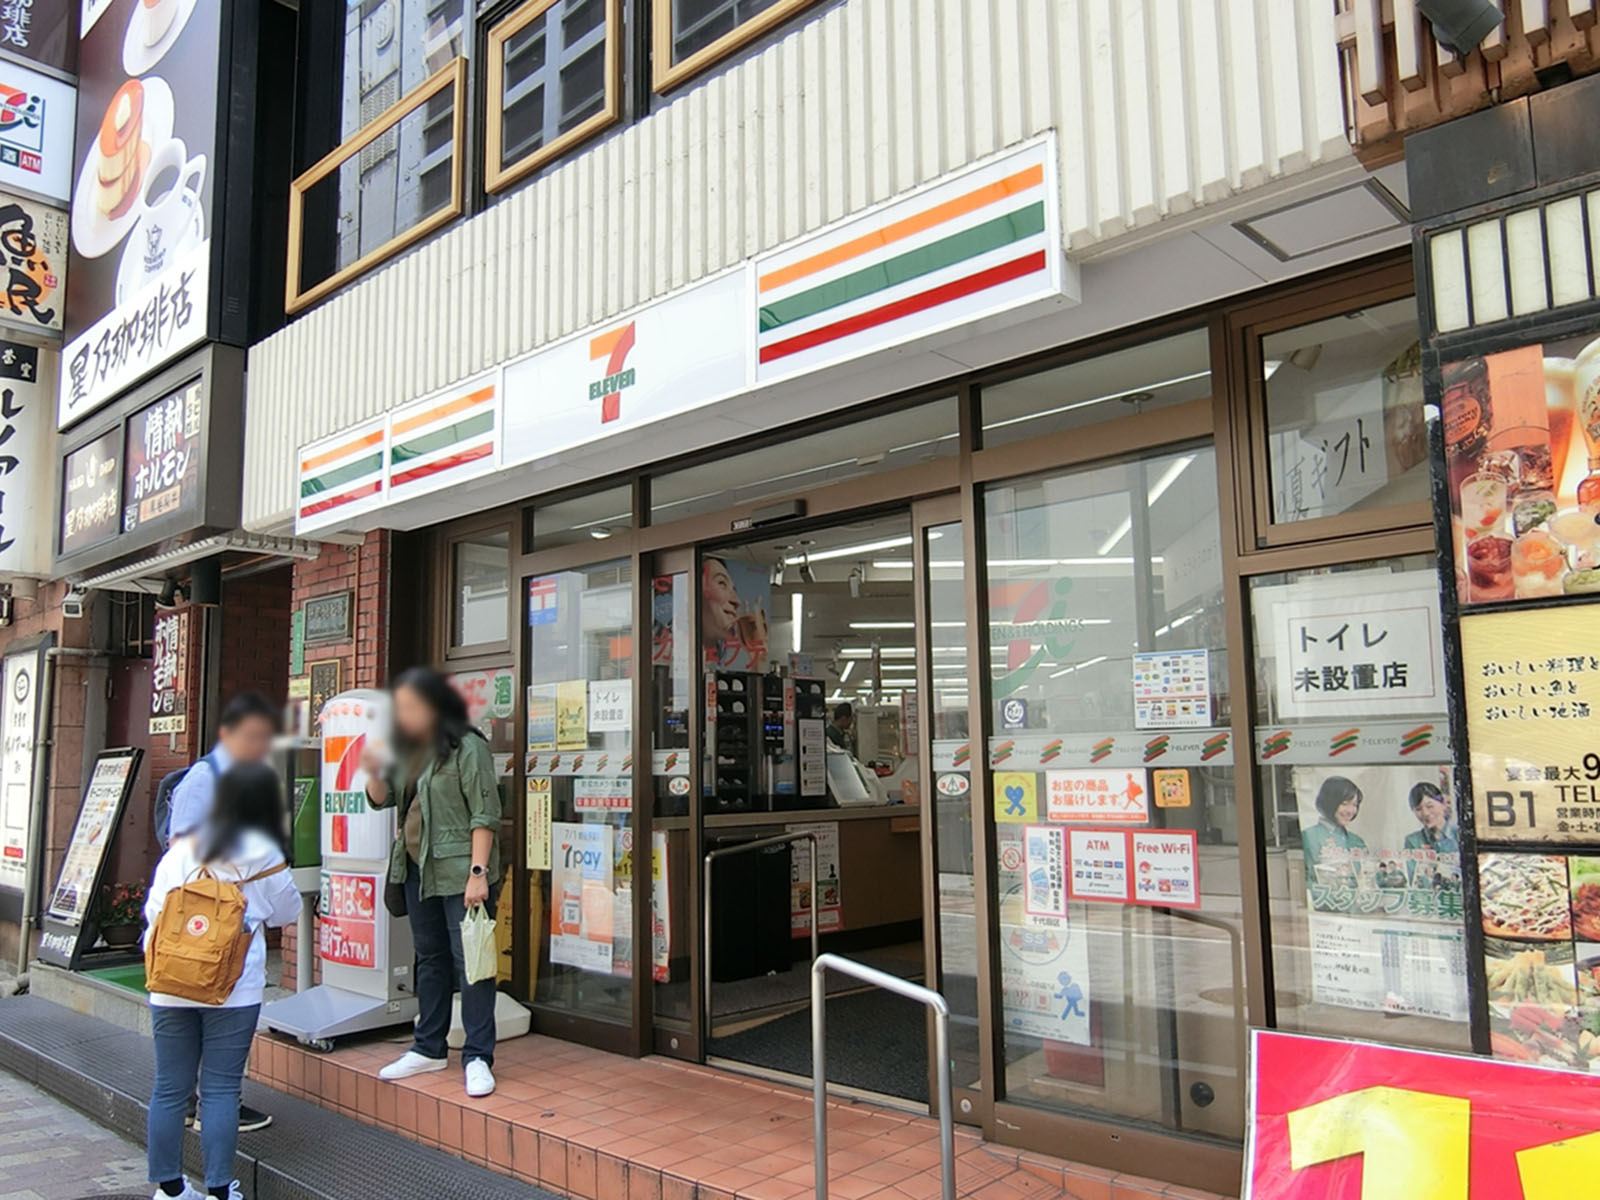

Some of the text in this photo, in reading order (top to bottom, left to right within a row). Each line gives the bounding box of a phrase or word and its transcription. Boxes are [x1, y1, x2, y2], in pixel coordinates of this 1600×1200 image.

[21, 153, 41, 174] ATM
[1301, 623, 1388, 653] トイレ
[1294, 661, 1407, 692] 未設置店
[1482, 656, 1599, 677] おいしい料理と
[596, 691, 620, 704] トイレ
[1484, 679, 1577, 698] おいしい魚と
[1486, 702, 1590, 720] おいしい地酒
[1052, 779, 1109, 792] お店の商品
[1052, 793, 1120, 807] お届けします
[1486, 790, 1537, 829] B1
[1086, 839, 1110, 851] ATM
[1136, 841, 1191, 855] Free Wi-Fi
[561, 843, 602, 871] 7pay
[332, 878, 373, 917] たばこ
[1312, 884, 1463, 920] スタッフ募集
